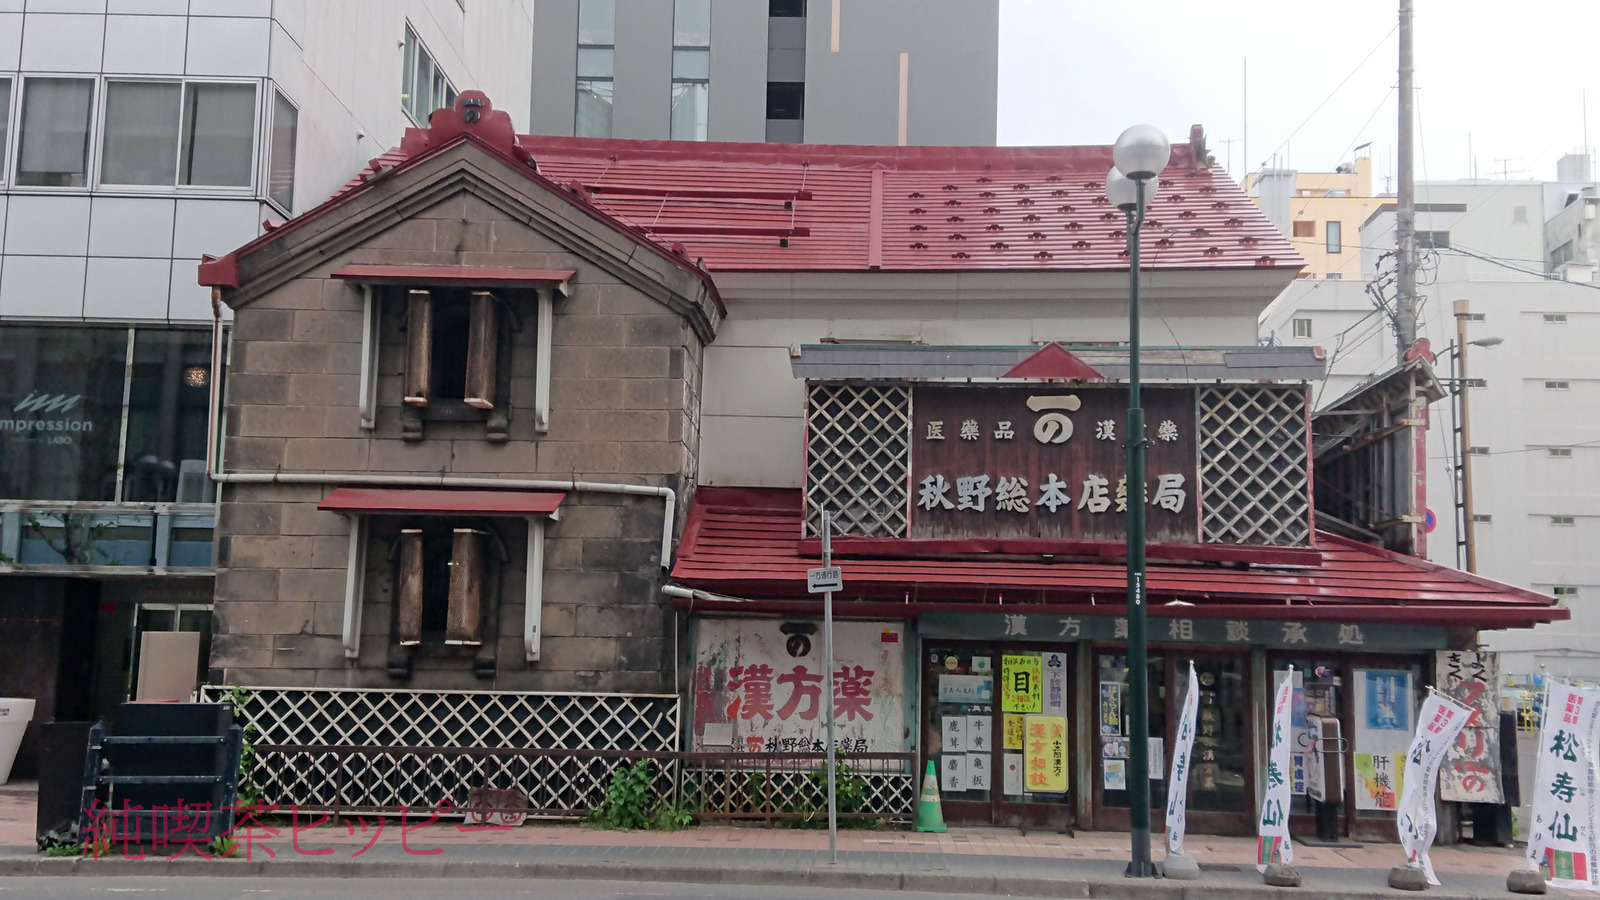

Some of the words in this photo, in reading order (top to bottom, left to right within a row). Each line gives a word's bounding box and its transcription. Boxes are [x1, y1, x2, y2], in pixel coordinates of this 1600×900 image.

[1013, 670, 1031, 694] 目
[948, 720, 960, 749] 鹿茸
[973, 719, 985, 749] 牛黄
[1372, 754, 1392, 808] 肝機能
[1547, 729, 1579, 842] 松寿仙
